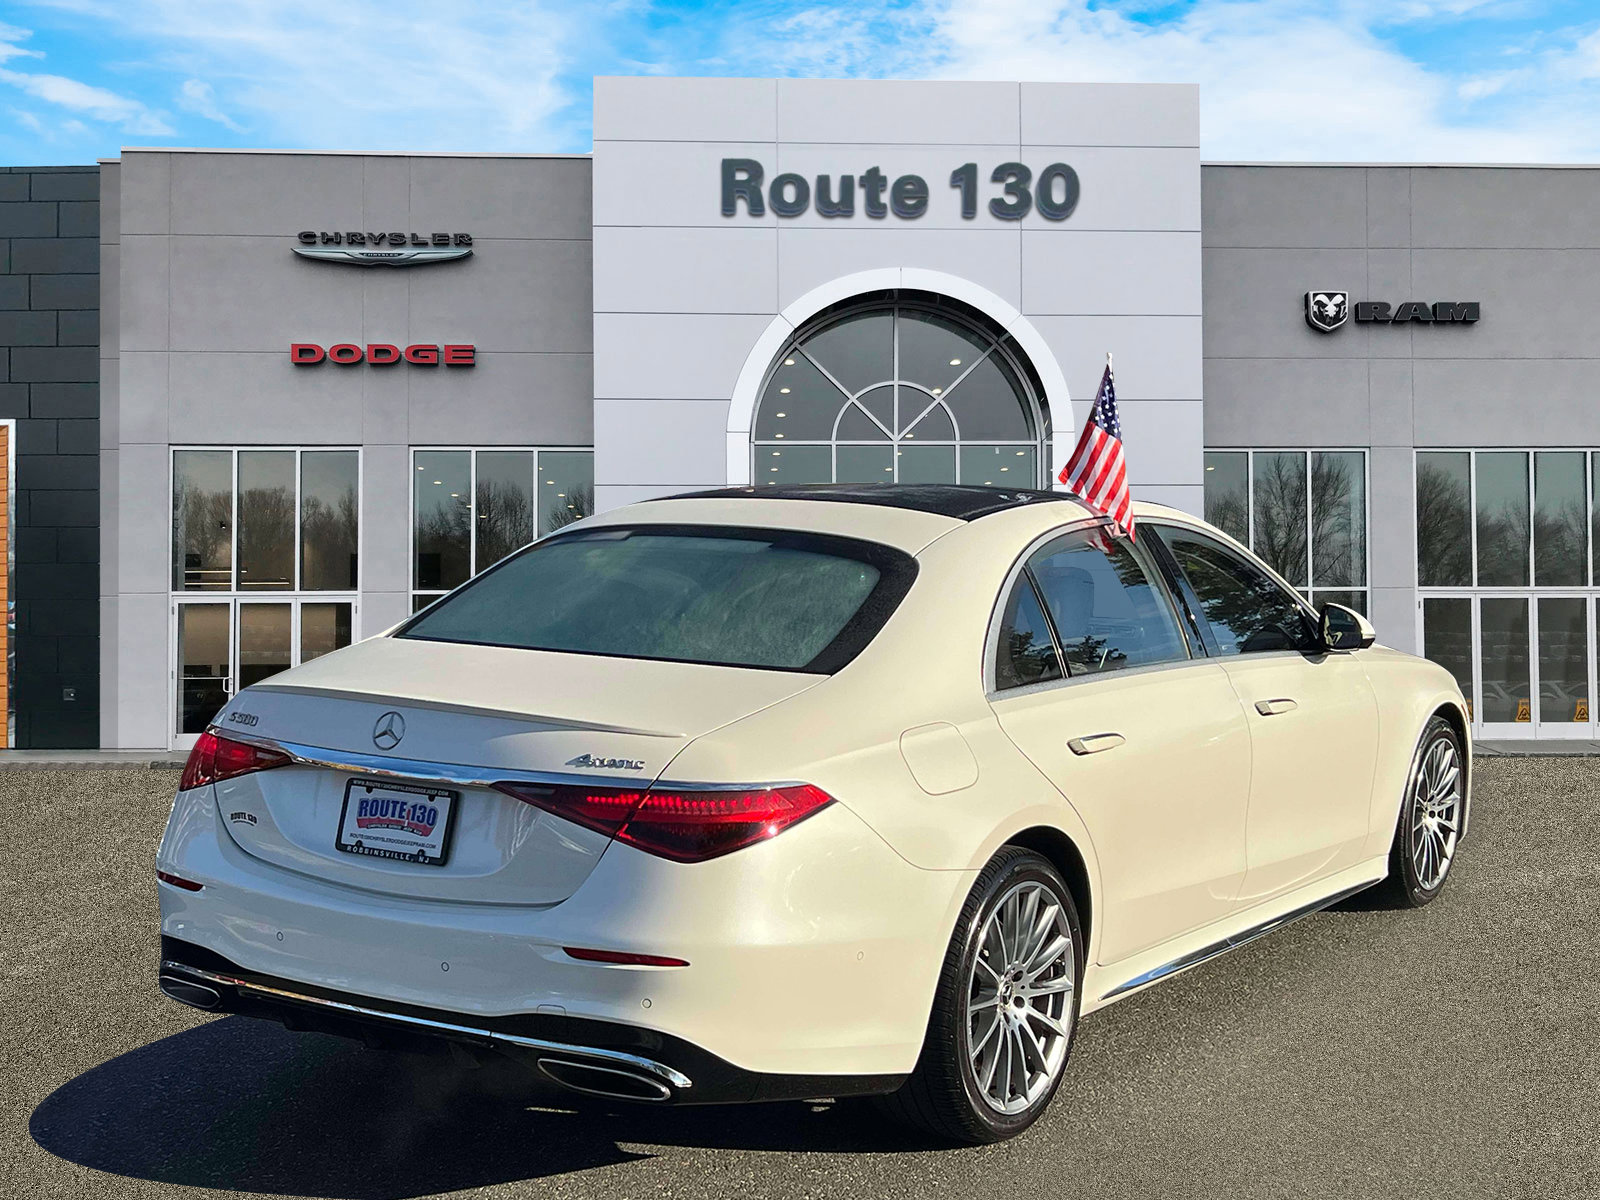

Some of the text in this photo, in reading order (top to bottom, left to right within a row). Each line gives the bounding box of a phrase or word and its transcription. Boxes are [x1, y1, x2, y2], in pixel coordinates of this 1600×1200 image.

[721, 158, 1080, 221] Route 130
[298, 231, 473, 246] CHRYSLER
[1355, 301, 1480, 324] RAM
[291, 343, 475, 367] DODGE
[230, 812, 247, 820] ROUTE
[358, 798, 438, 827] ROUTE 130
